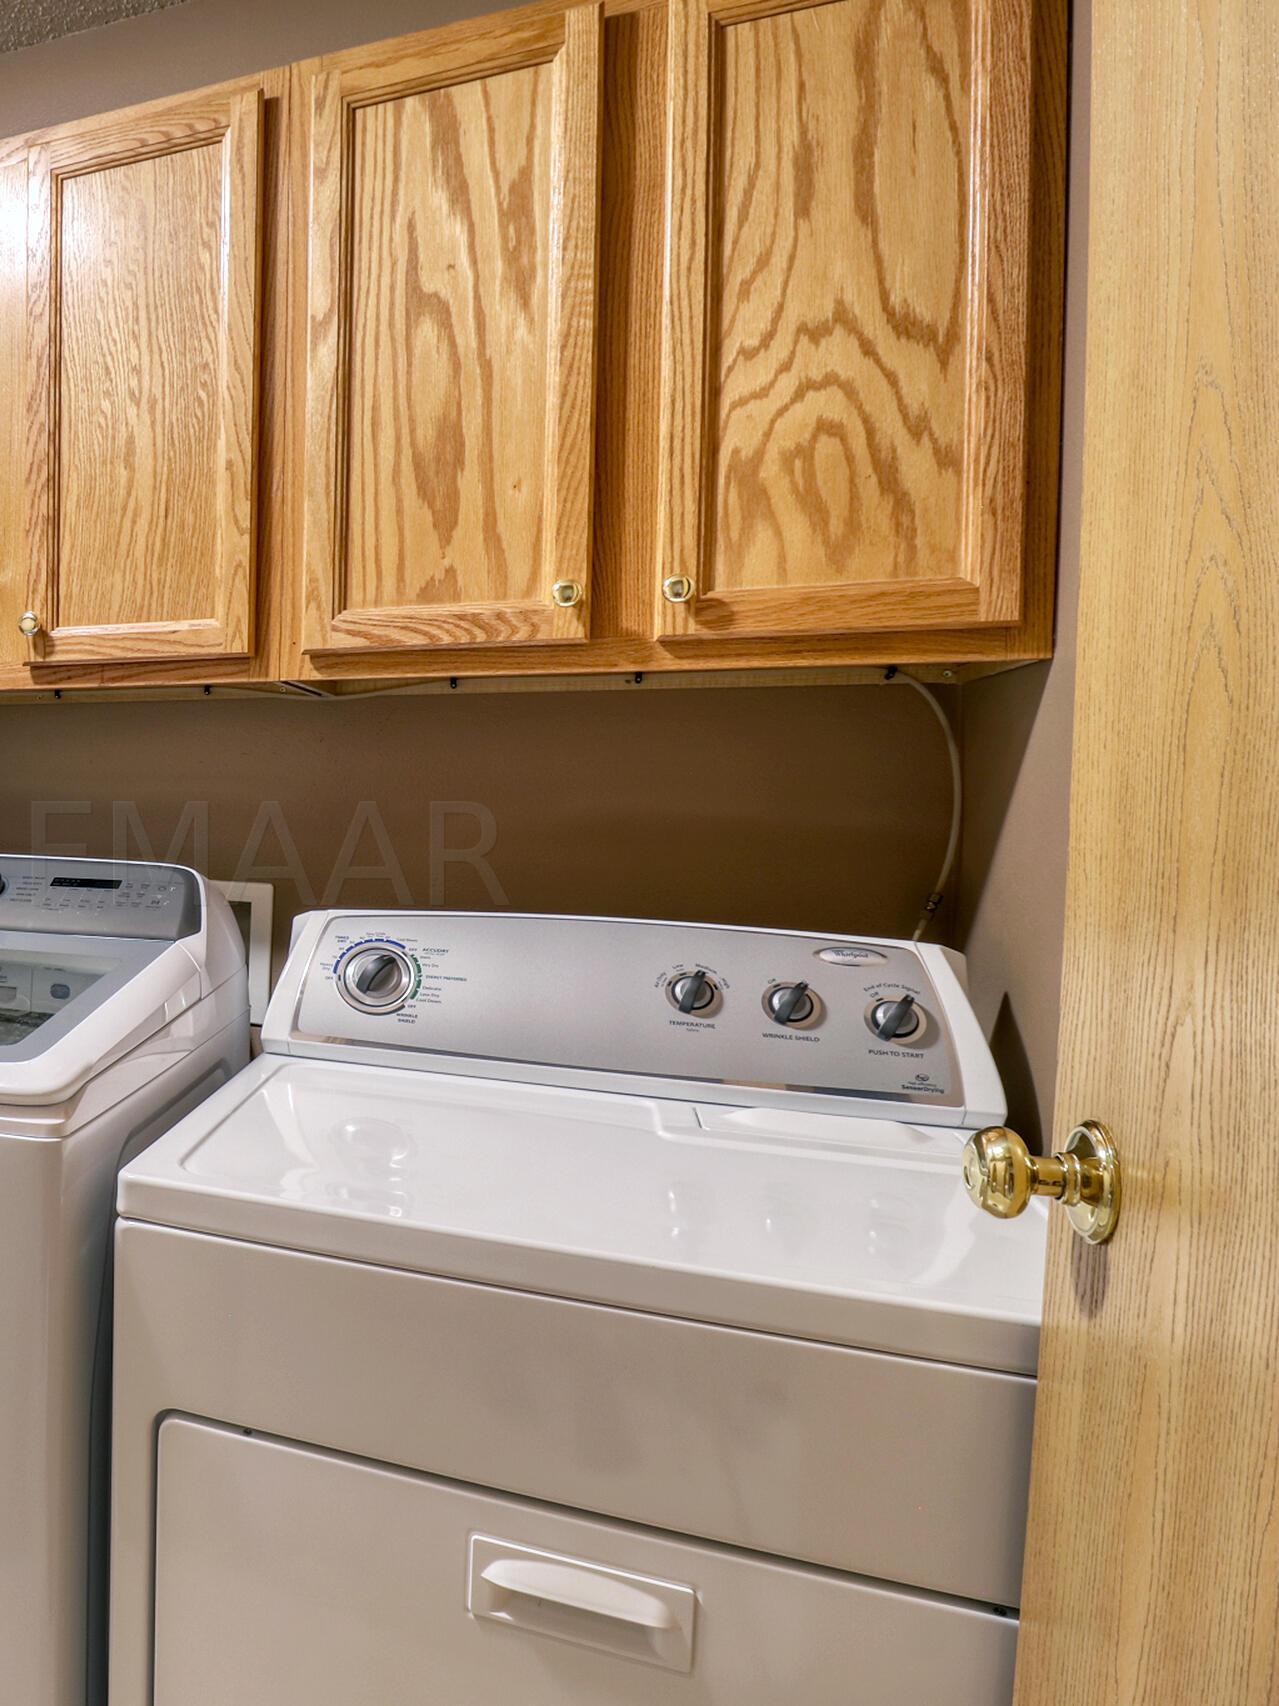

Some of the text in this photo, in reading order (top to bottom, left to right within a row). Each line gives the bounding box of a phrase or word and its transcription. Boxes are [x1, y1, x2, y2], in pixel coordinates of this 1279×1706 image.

[833, 950, 869, 959] Whirlpool
[669, 1020, 716, 1029] TEMPERATURE
[762, 1032, 821, 1043] WRINKLE SHIELD
[868, 1049, 889, 1057] PUSH
[901, 1051, 924, 1059] START
